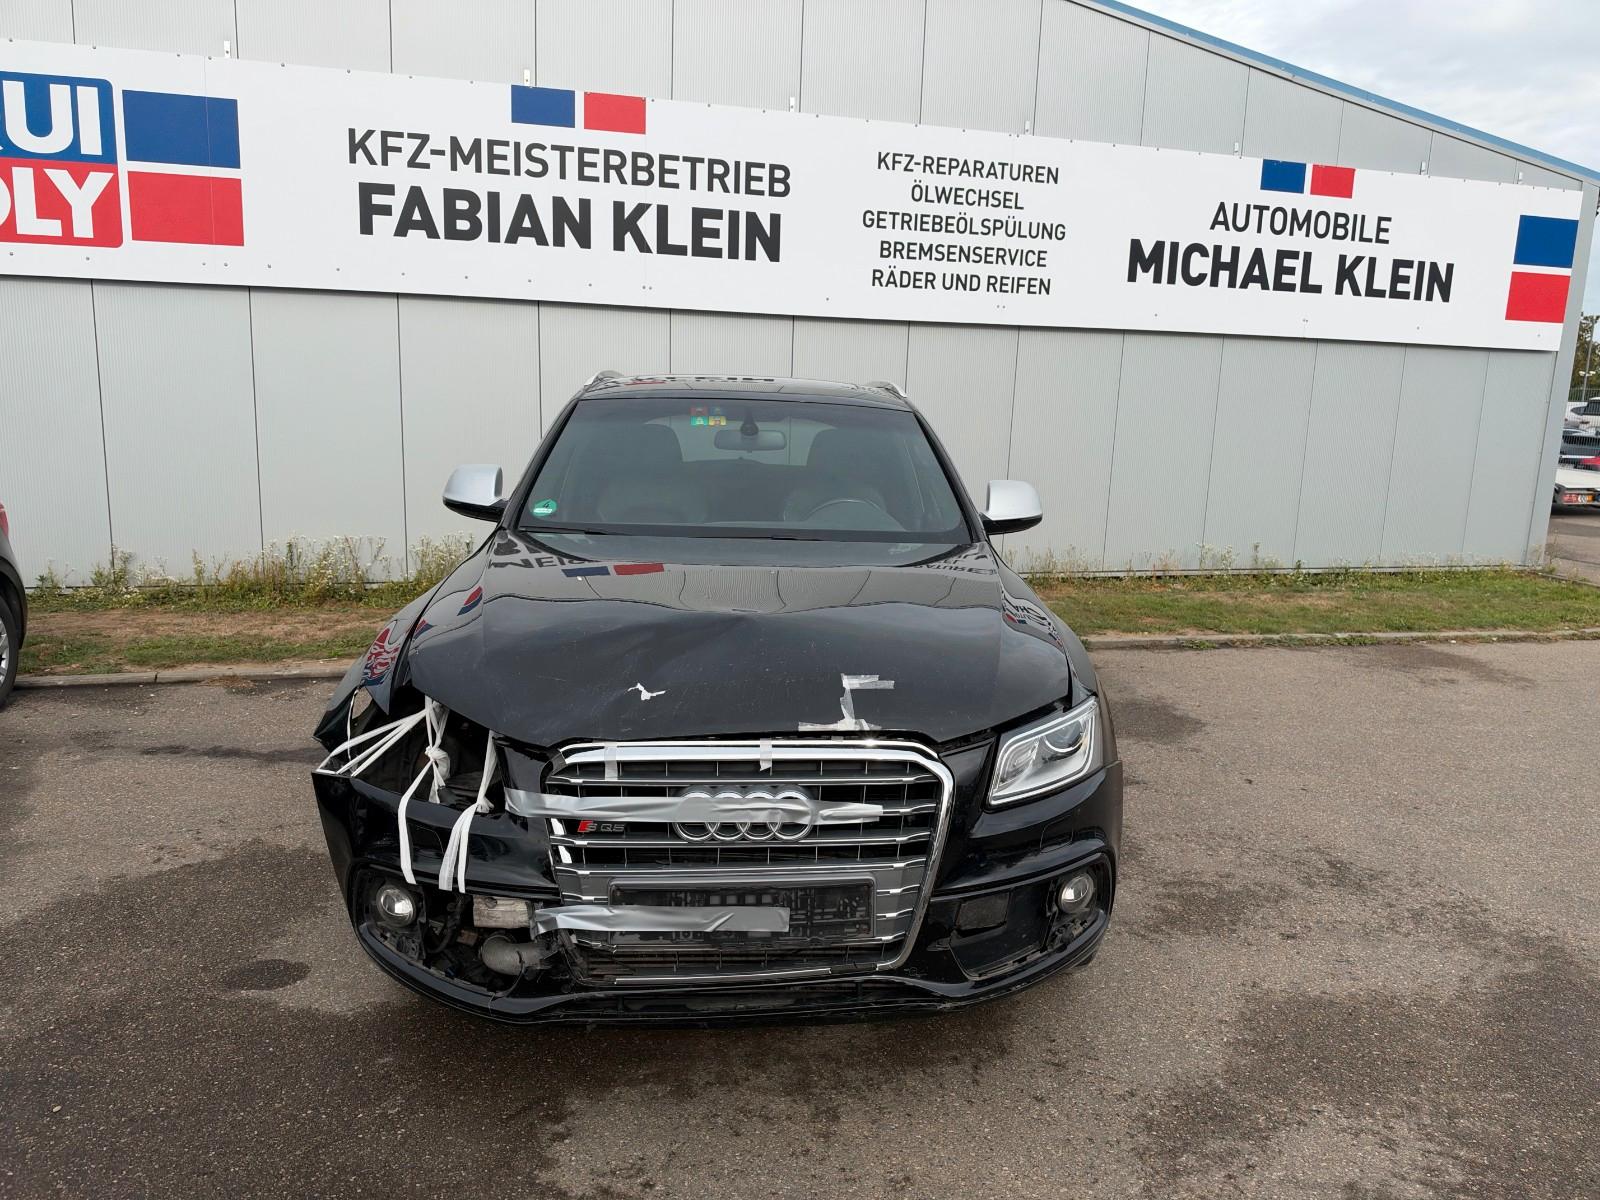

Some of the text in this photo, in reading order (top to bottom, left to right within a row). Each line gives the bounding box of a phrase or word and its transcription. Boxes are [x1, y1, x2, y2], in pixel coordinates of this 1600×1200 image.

[0, 79, 103, 156] UI
[348, 127, 791, 198] KFZ-MEISTERBETRIEB
[877, 151, 1059, 185] KFZ-REPARATUREN
[0, 166, 115, 239] LY
[911, 179, 1025, 210] ÖLWECHSEL
[358, 181, 781, 263] FABIAN KLEIN
[862, 209, 1066, 241] GETRIEBEÖLSPÜLUNG
[1209, 201, 1393, 245] AUTOMOBILE
[879, 240, 1048, 268] BREMSENSERVICE
[1126, 238, 1455, 303] MICHAEL KLEIN
[871, 265, 1051, 296] RÄDER UND REIFEN
